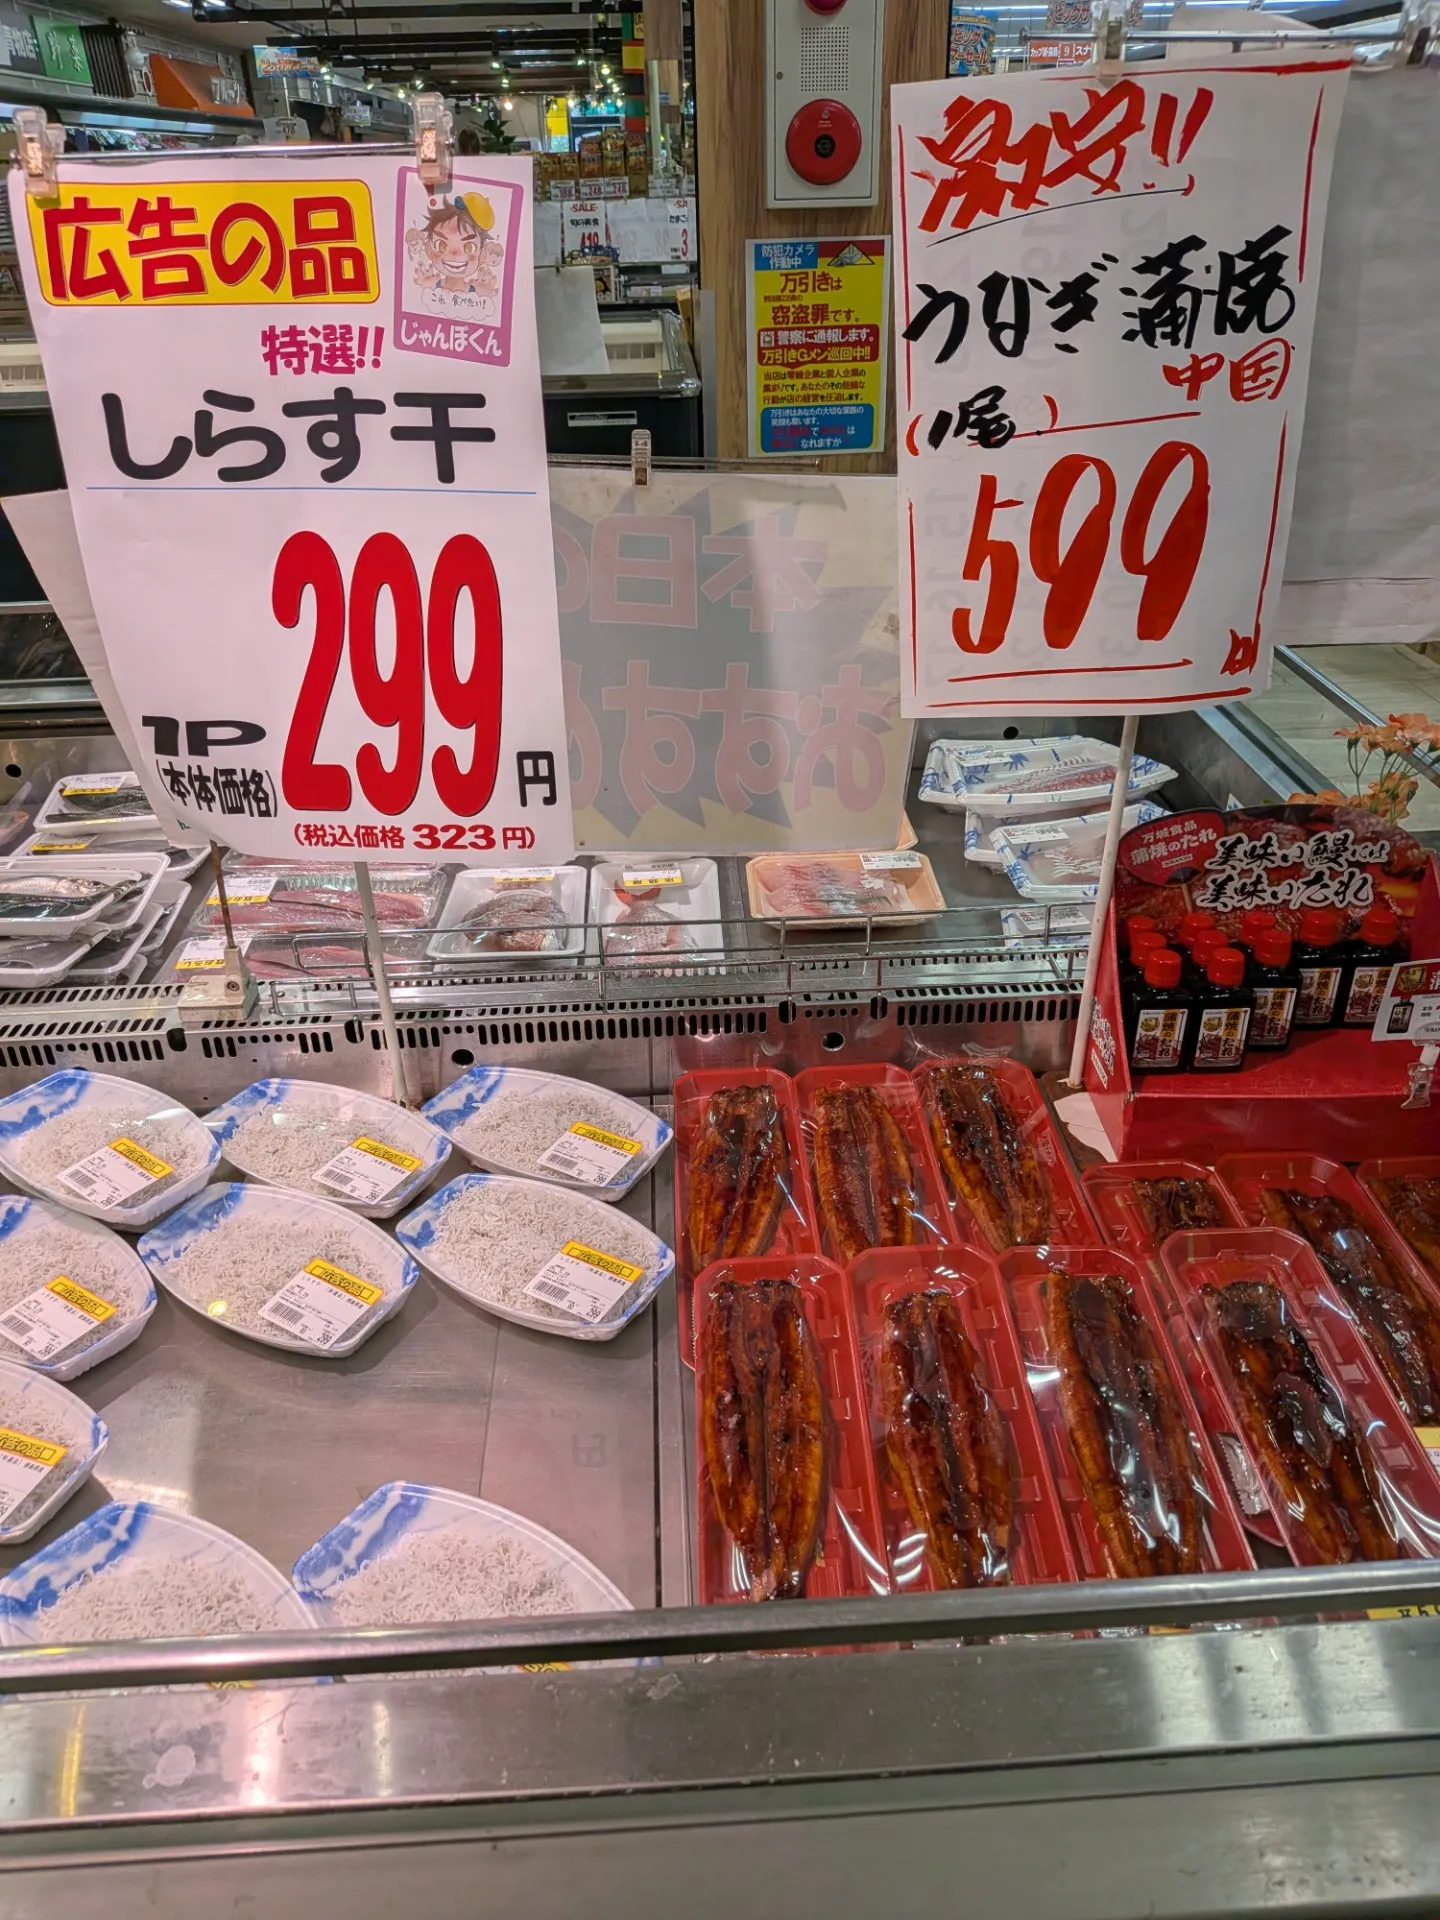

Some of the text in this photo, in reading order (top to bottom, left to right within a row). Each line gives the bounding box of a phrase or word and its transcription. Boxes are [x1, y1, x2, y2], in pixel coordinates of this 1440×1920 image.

[1064, 45, 1070, 57] 9
[572, 203, 596, 213] SALE
[43, 196, 369, 300] 広告の品
[762, 244, 815, 257] 防犯カメラ
[769, 256, 802, 269] 作動中
[431, 293, 487, 310] これ 食べたい!
[780, 271, 843, 293] 万引きは
[902, 225, 1296, 364] うなぎ蒲焼
[771, 303, 860, 326] 窃盗罪です。
[261, 323, 385, 376] 特選!!
[400, 317, 504, 358] じゃんぼくん
[762, 346, 871, 364] 万引きGメン巡回中!!
[777, 328, 874, 345] 警察に通報します。
[1162, 337, 1291, 402] 中国
[101, 386, 496, 484] しらす干
[951, 441, 1211, 655] 599
[271, 529, 502, 818] 299
[141, 715, 267, 757] 1P
[155, 759, 278, 818] (本体価格)
[516, 750, 557, 808] 円
[294, 823, 536, 851] (税込価格 323 円)
[1130, 828, 1218, 866] 蒲焼のたれ
[1141, 819, 1198, 844] 万城食品
[1207, 831, 1388, 872] 美味い鰻には
[1199, 868, 1371, 910] 美味いたれ
[1157, 1011, 1179, 1058] 蒲焼のたれ
[1220, 1010, 1241, 1057] 蒲焼のたれ
[319, 1264, 366, 1298] 広告の品
